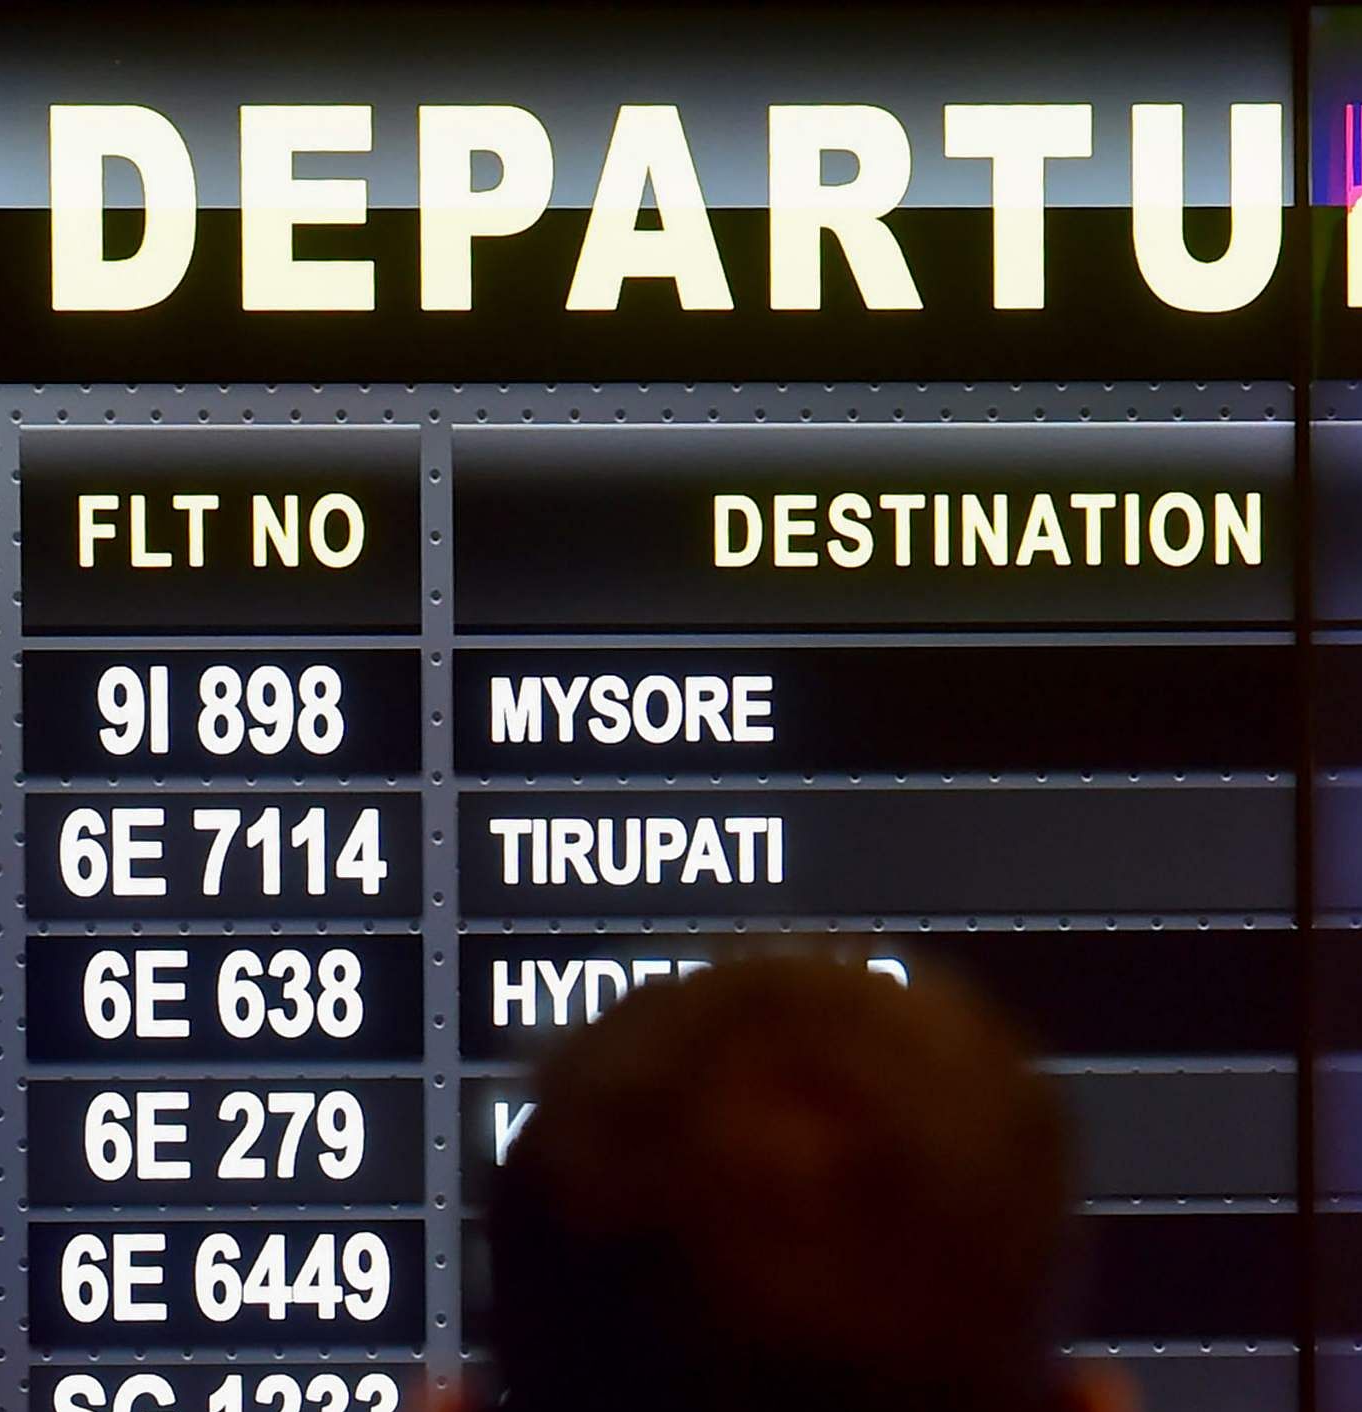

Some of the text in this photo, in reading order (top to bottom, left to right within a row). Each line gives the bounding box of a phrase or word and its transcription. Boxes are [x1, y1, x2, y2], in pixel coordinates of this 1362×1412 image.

[78, 493, 365, 568] FLT NO
[714, 491, 1262, 568] DESTINATION
[97, 665, 345, 755] 9I 898
[491, 675, 774, 744] MYSORE
[59, 807, 388, 897] 6E 7114
[489, 817, 783, 886] TIRUPATI
[83, 948, 364, 1039] 6E 638
[84, 1090, 365, 1181] 6E 279
[61, 1231, 391, 1323] 6E 6449
